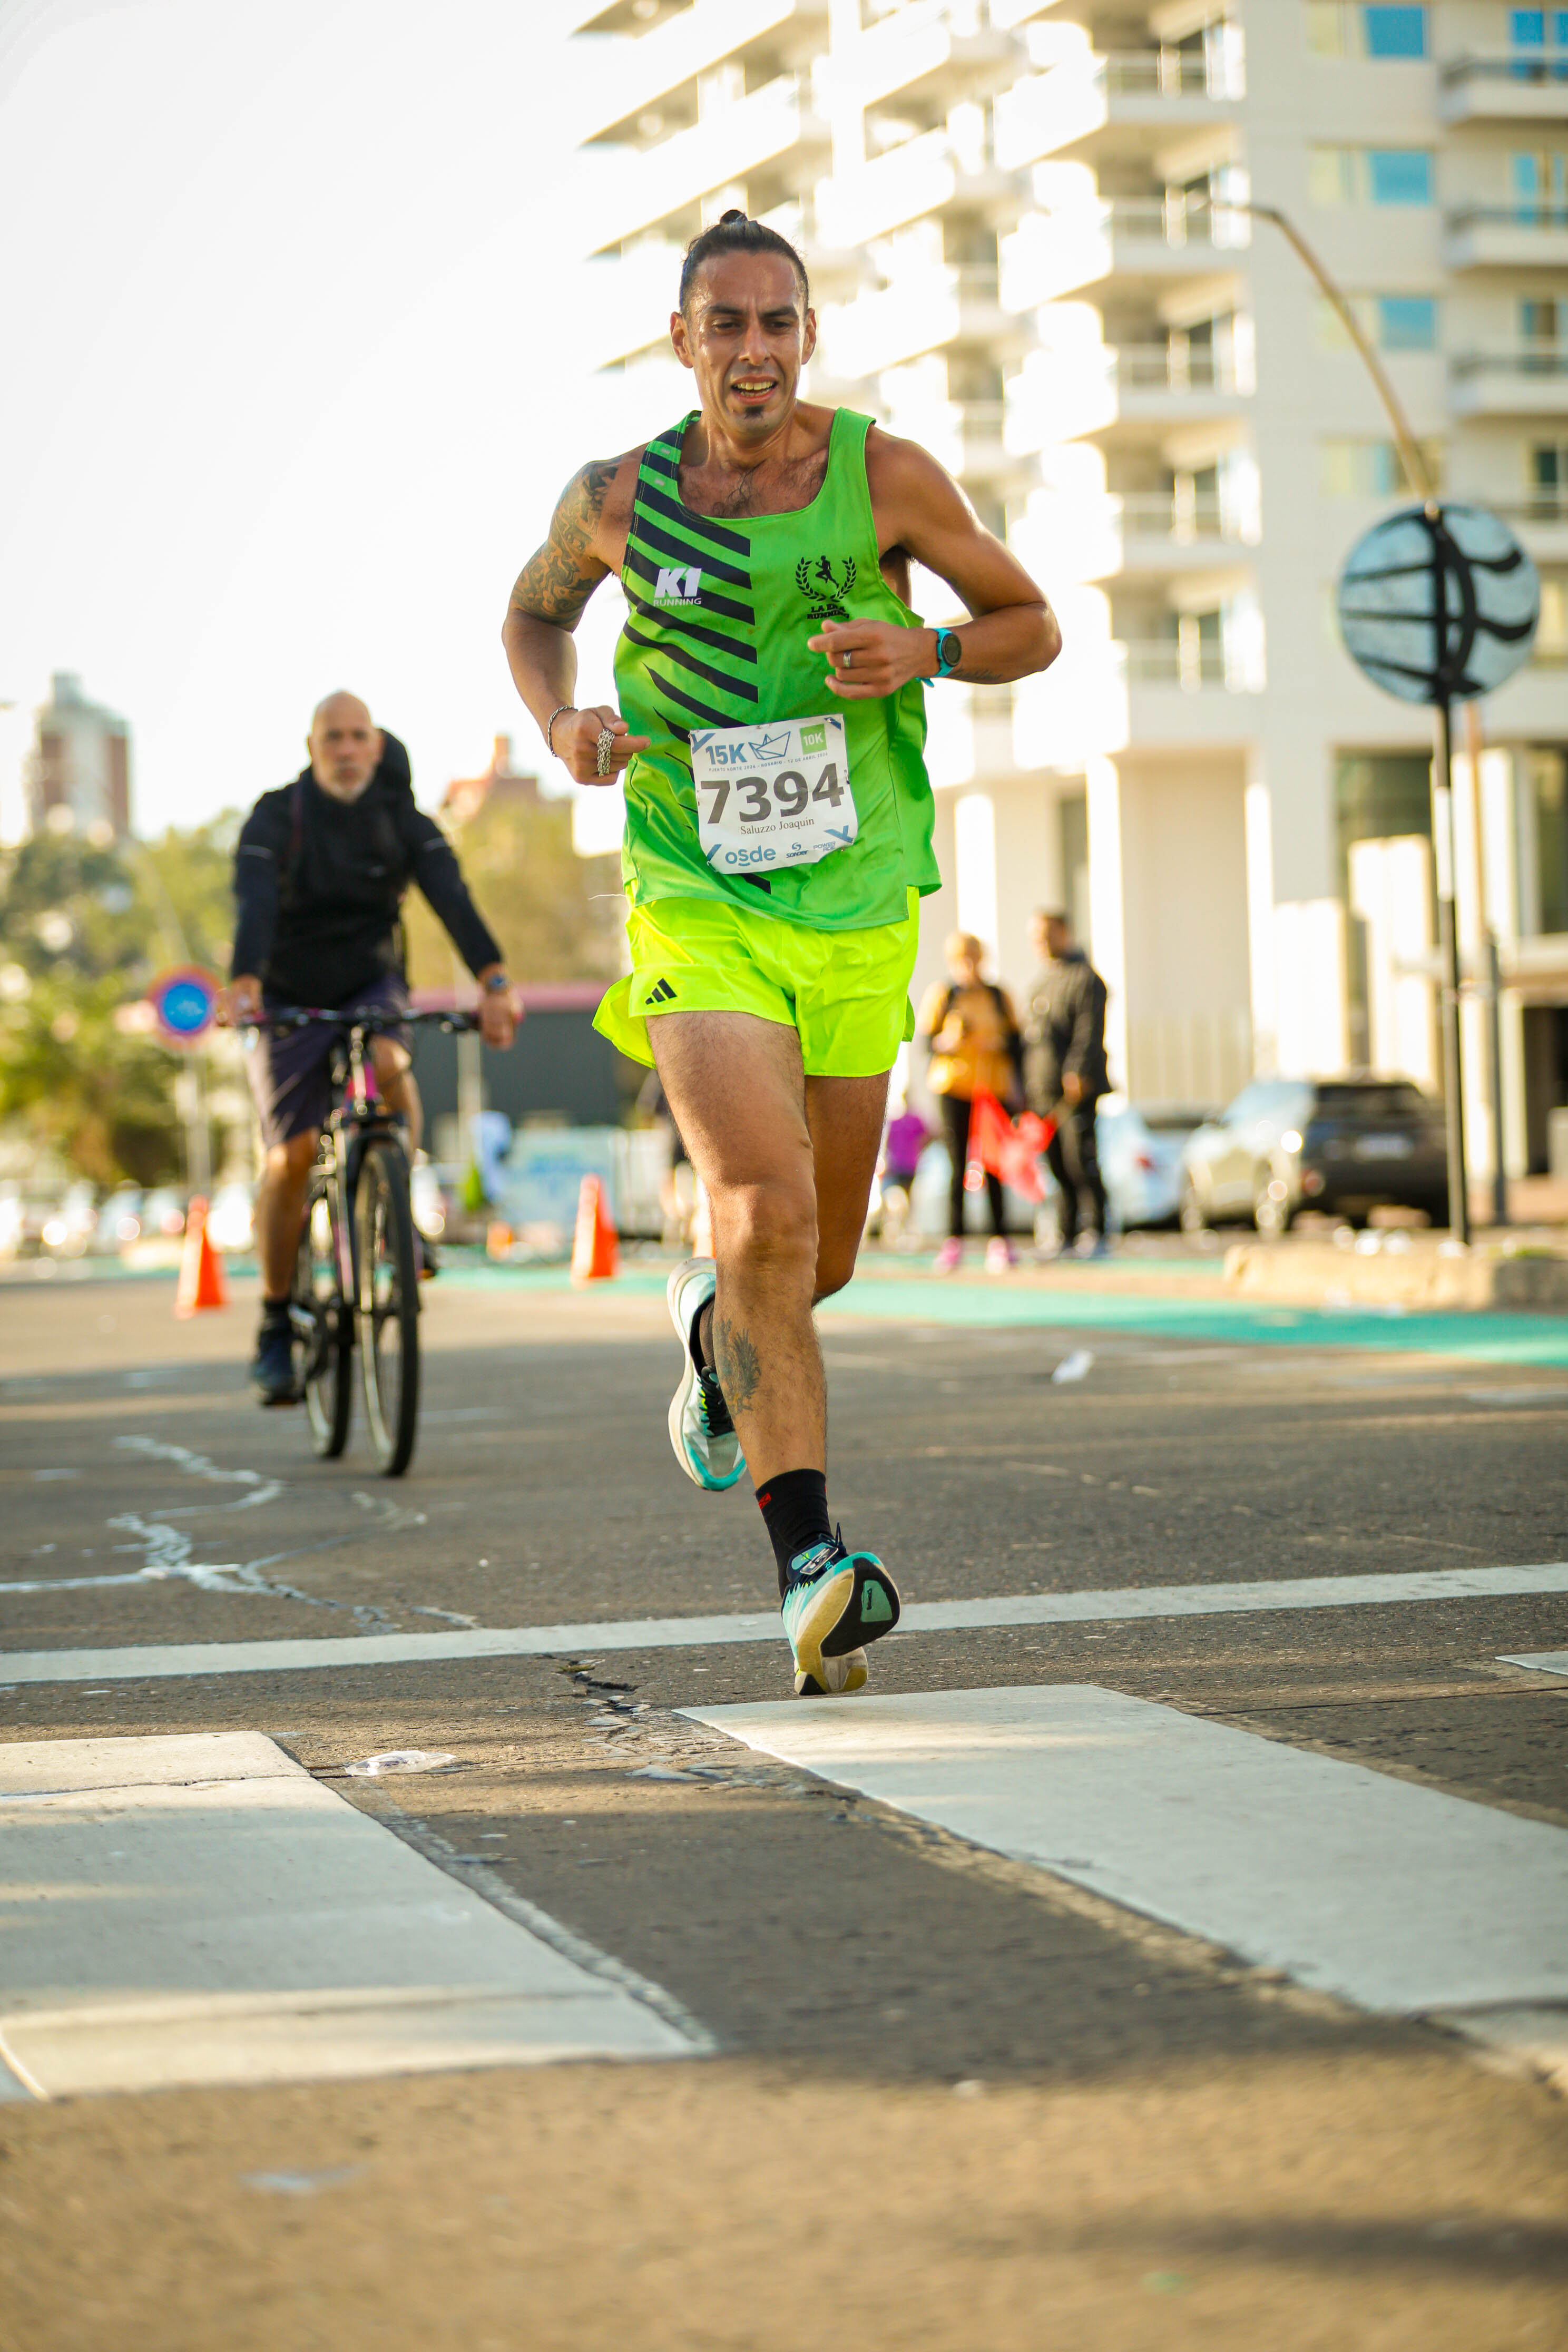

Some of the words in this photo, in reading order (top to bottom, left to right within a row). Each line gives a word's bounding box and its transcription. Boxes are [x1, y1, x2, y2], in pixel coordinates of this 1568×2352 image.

[654, 567, 702, 597] K1
[653, 597, 702, 606] RUNNING
[803, 732, 823, 746] 10K
[705, 743, 748, 765] 15K
[701, 762, 844, 824] 7394
[740, 825, 776, 835] Saluzzo
[779, 817, 814, 830] Joaquin
[725, 845, 776, 865] osde
